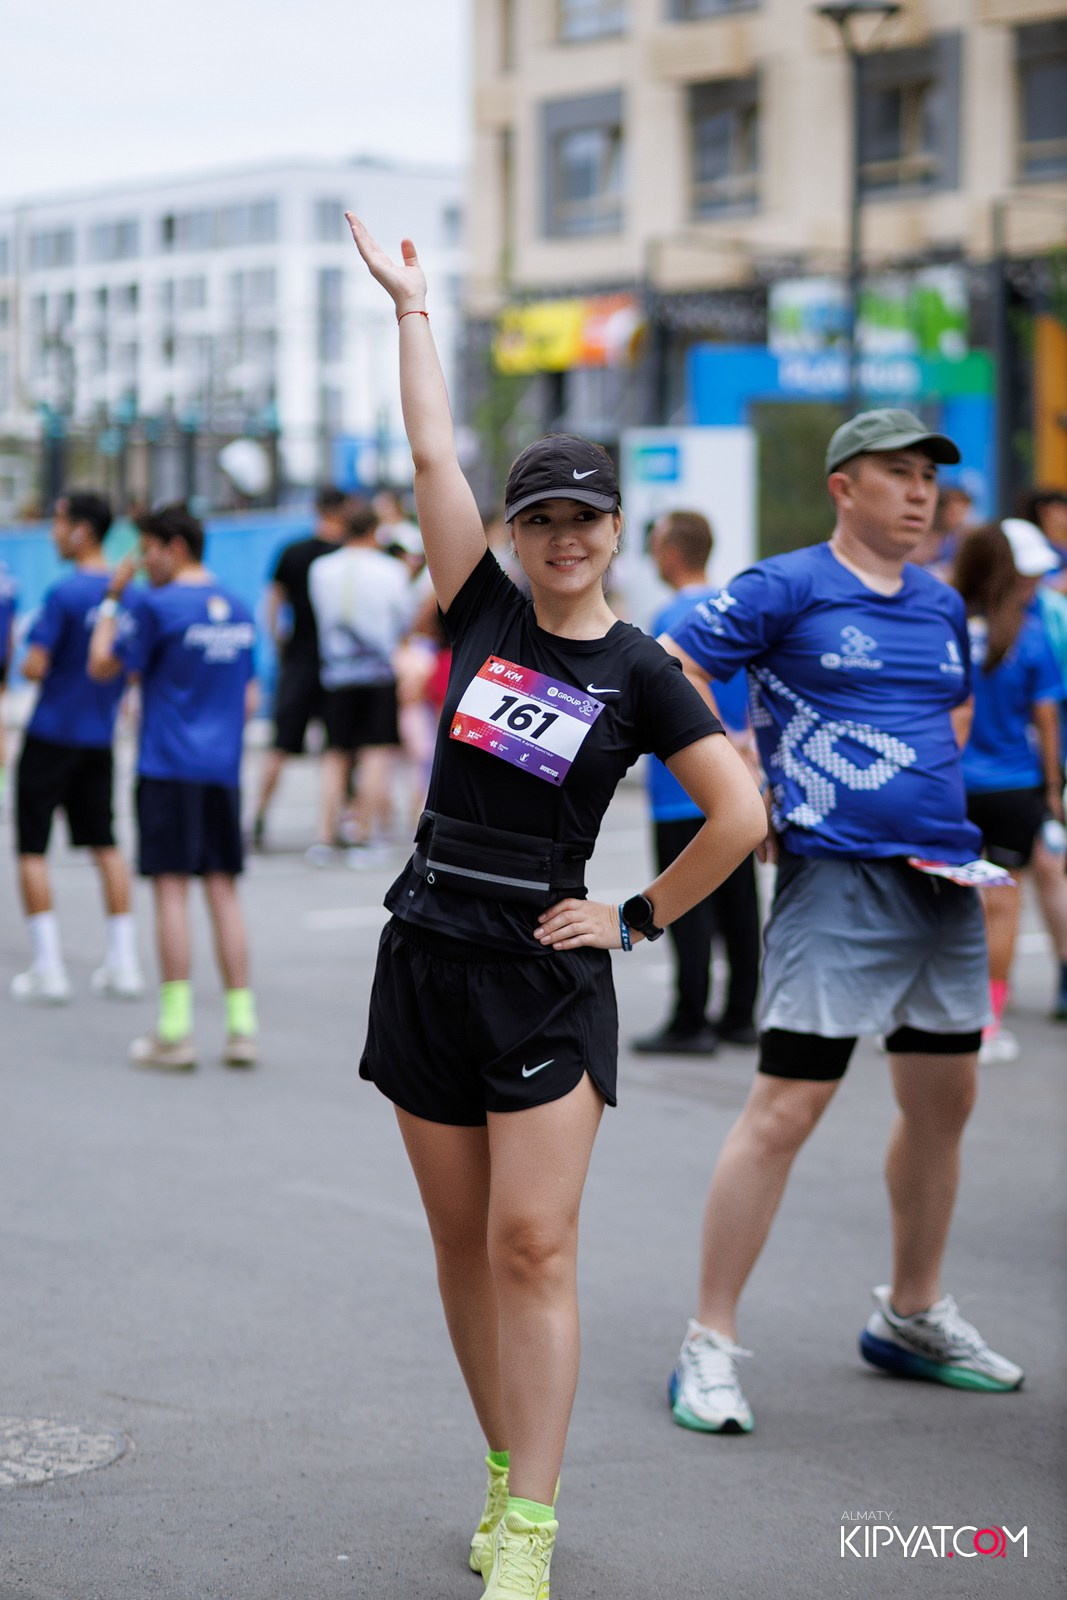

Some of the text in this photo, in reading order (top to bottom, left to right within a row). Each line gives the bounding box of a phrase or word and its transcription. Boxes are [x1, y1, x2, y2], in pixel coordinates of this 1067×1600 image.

[488, 662, 506, 674] 10
[557, 692, 581, 706] GROUP
[489, 695, 559, 740] 161
